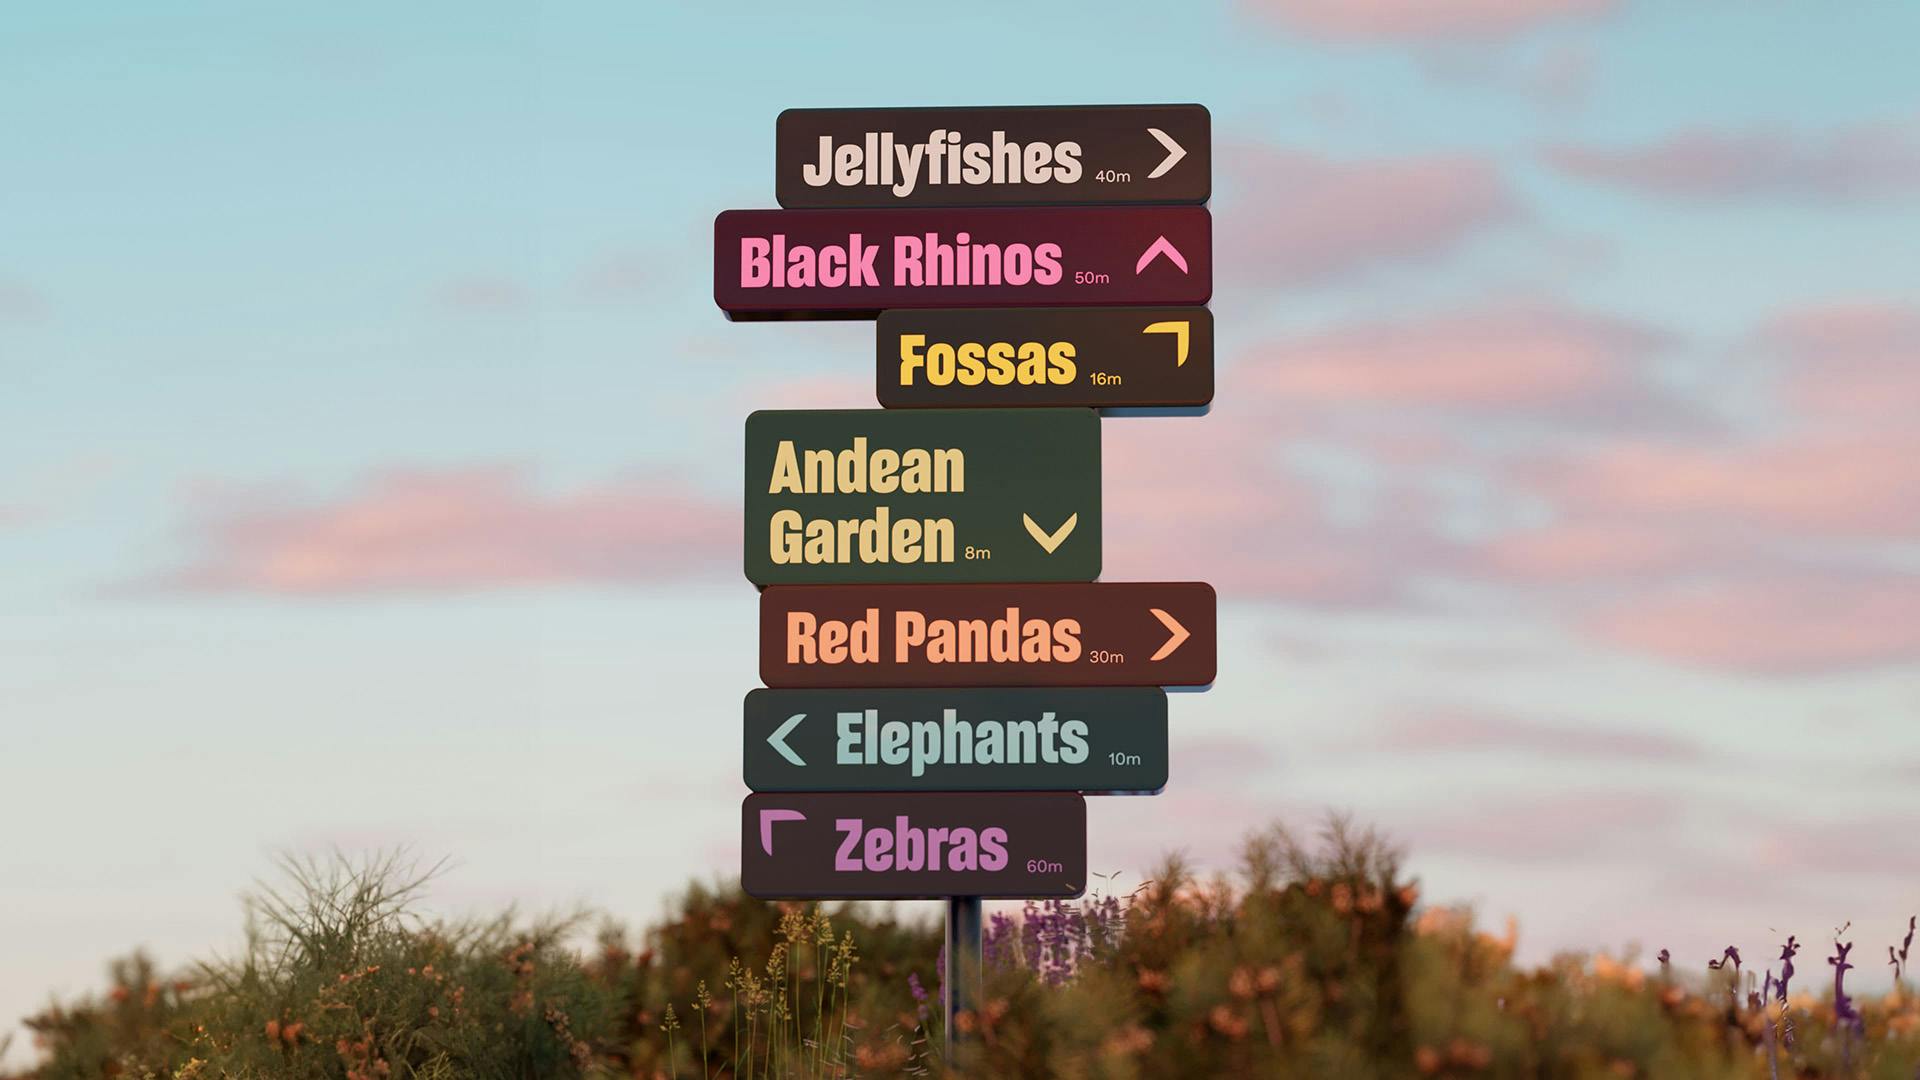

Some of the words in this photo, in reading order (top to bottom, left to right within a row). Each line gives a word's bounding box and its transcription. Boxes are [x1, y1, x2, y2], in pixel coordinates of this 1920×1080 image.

[803, 129, 1082, 197] Jellyfishes
[1096, 170, 1130, 182] 40m
[741, 234, 880, 288] Black
[894, 232, 1062, 286] Rhinos
[1075, 272, 1109, 284] 50m
[901, 335, 1076, 385] Fossas
[1090, 372, 1121, 385] 16m
[769, 437, 964, 493] Andean
[770, 507, 954, 564] Garden
[965, 546, 990, 559] 8m
[787, 608, 879, 664] Red
[896, 607, 1081, 663] Pandas
[1090, 651, 1123, 663] 30m
[837, 709, 1089, 777] Elephants
[1109, 752, 1140, 765] 10m
[835, 816, 1008, 871] Zebras
[1027, 860, 1062, 873] 60m
